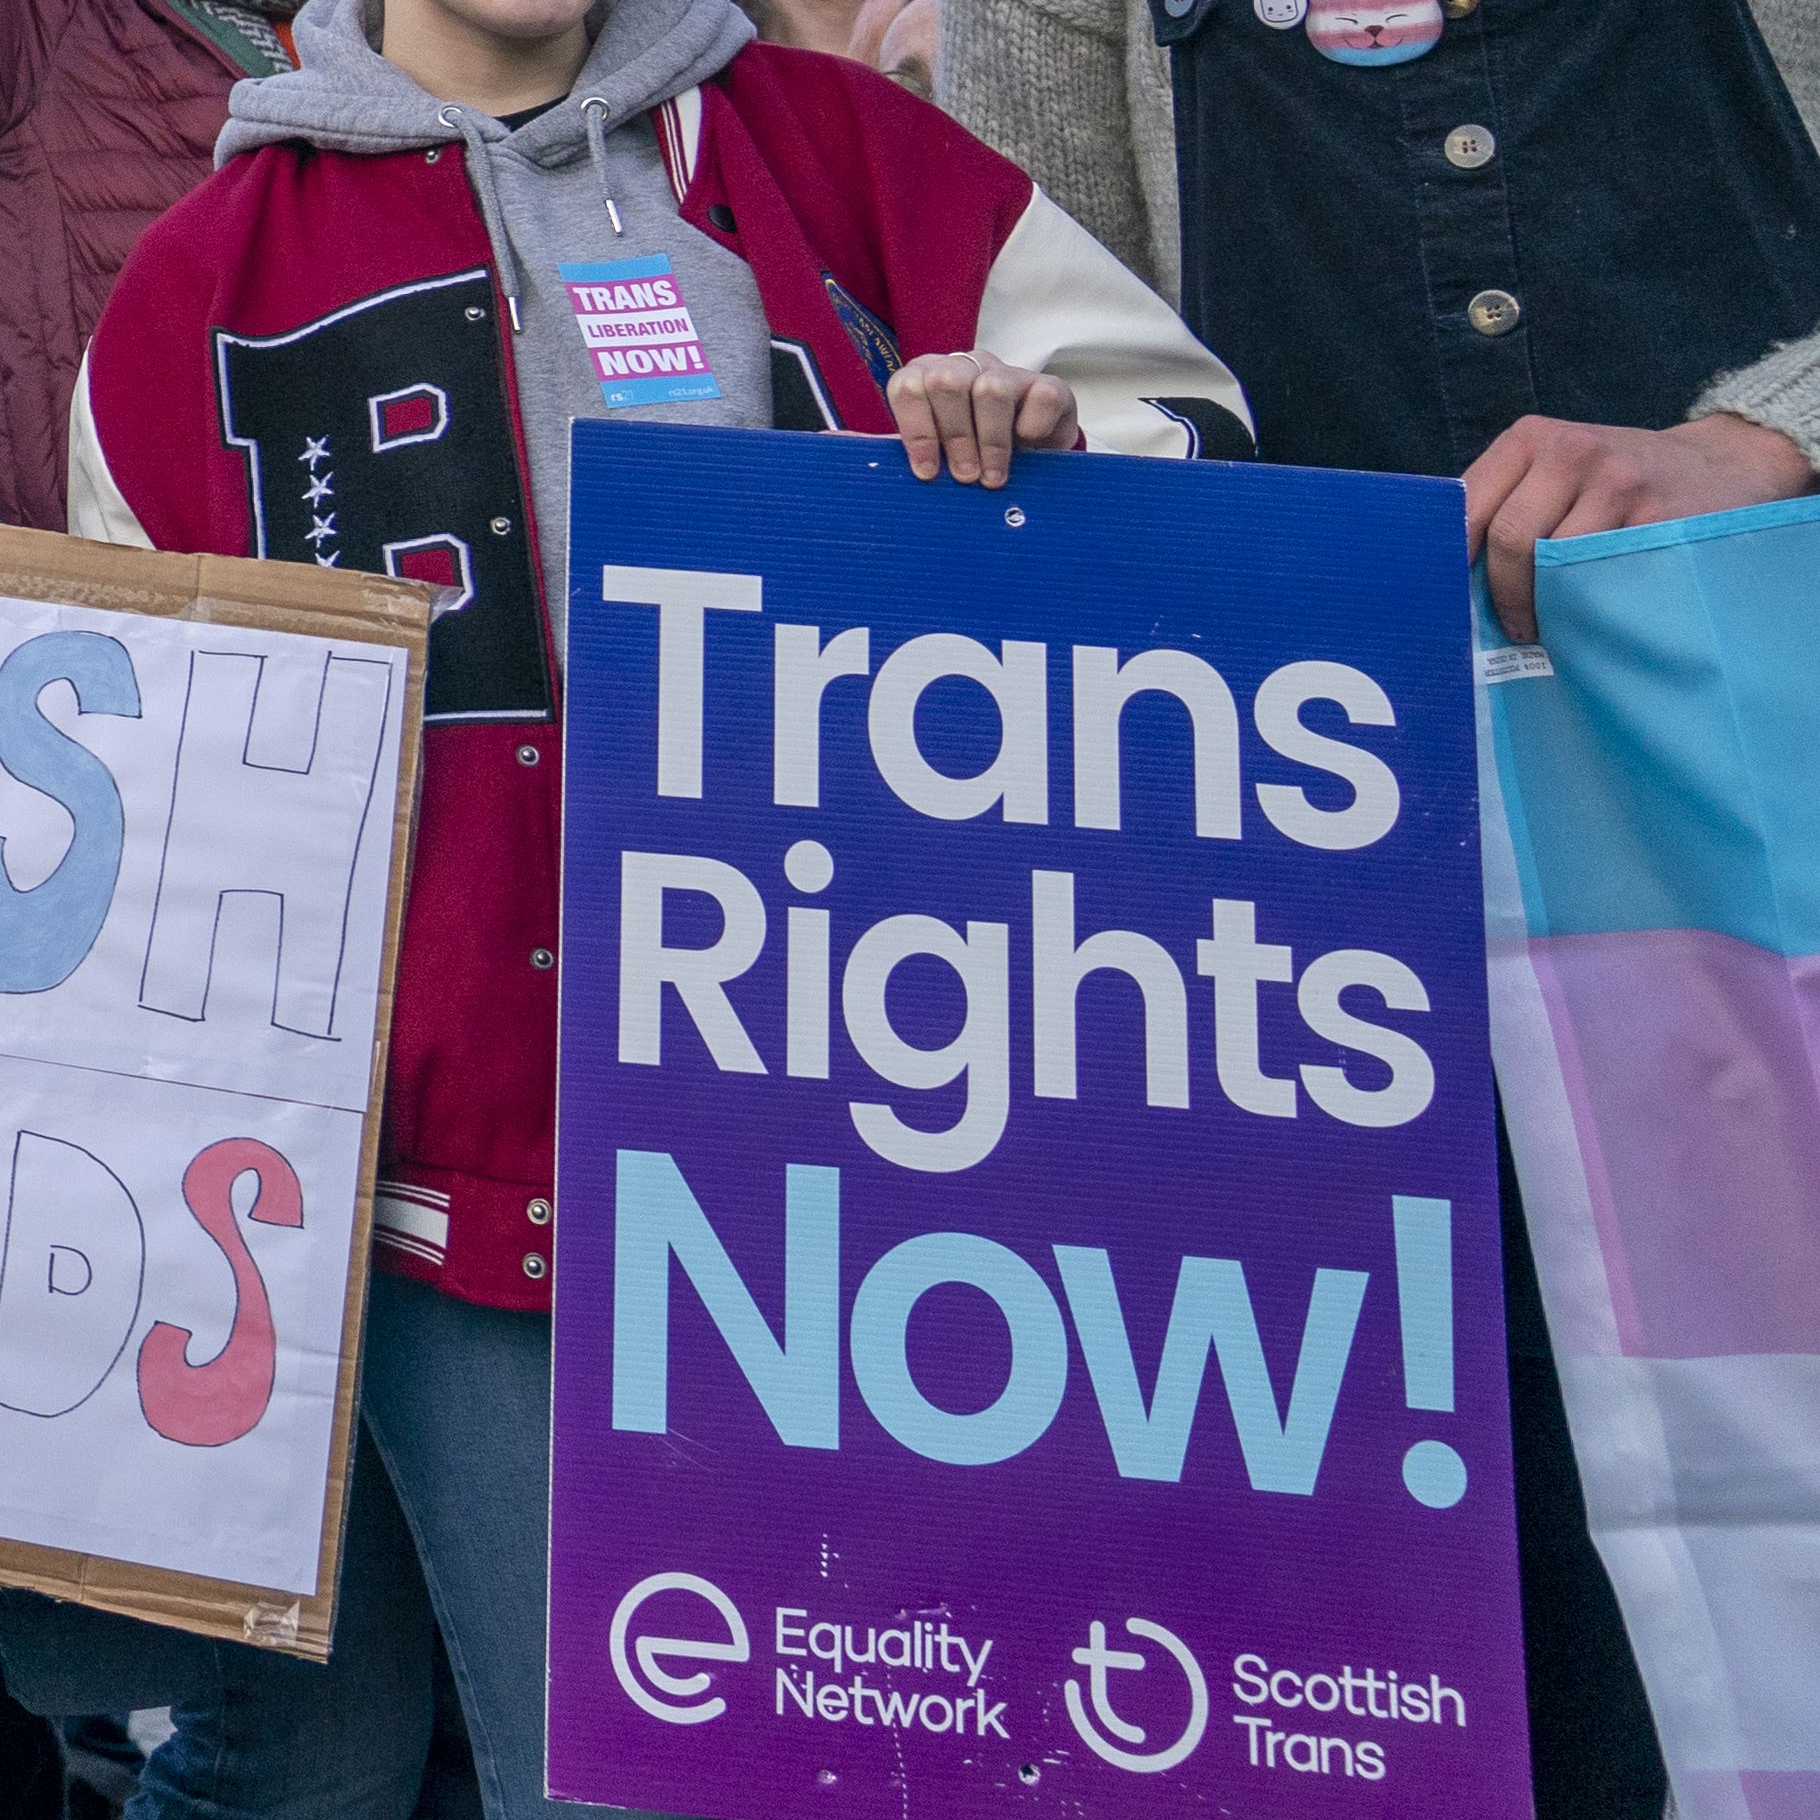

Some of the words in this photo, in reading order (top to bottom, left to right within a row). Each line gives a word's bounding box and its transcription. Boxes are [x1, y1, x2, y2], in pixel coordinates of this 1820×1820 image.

[573, 280, 677, 311] TRANS
[587, 318, 689, 338] LIBERATION
[598, 345, 704, 376] NOW!
[602, 565, 1401, 850] Trans
[618, 840, 1436, 1174] Rights
[611, 1149, 1469, 1510] Now!
[774, 1606, 993, 1688] Equality
[774, 1665, 1008, 1741] Network
[1232, 1653, 1466, 1728] Scottish
[1234, 1715, 1386, 1782] Trans
